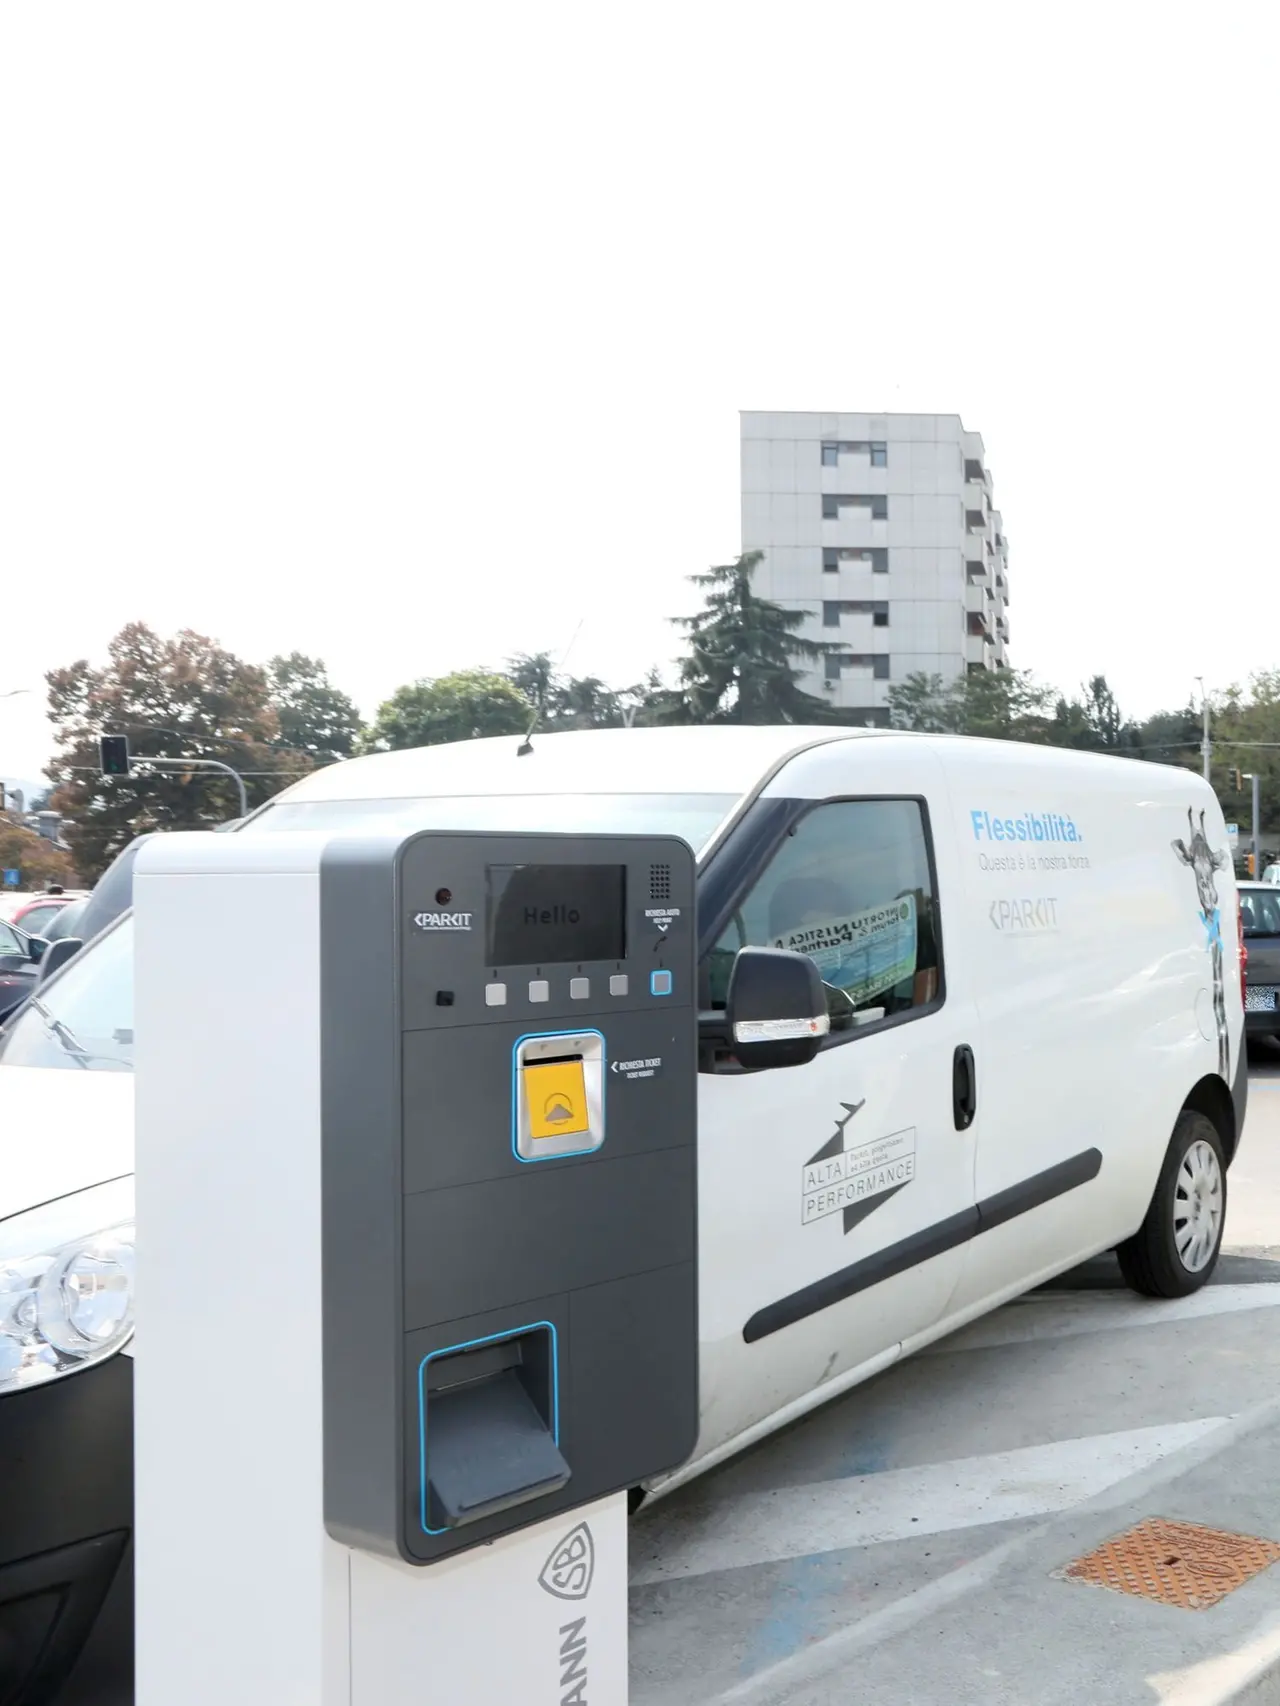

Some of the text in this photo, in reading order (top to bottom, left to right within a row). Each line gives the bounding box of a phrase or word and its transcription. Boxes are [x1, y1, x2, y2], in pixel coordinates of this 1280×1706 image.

[970, 810, 1083, 843] Flessibilità.
[978, 852, 1017, 871] Questa
[1027, 853, 1037, 870] la
[524, 904, 580, 925] Hello
[807, 1162, 843, 1188] ALTA
[806, 1160, 913, 1217] PERFORMANCE
